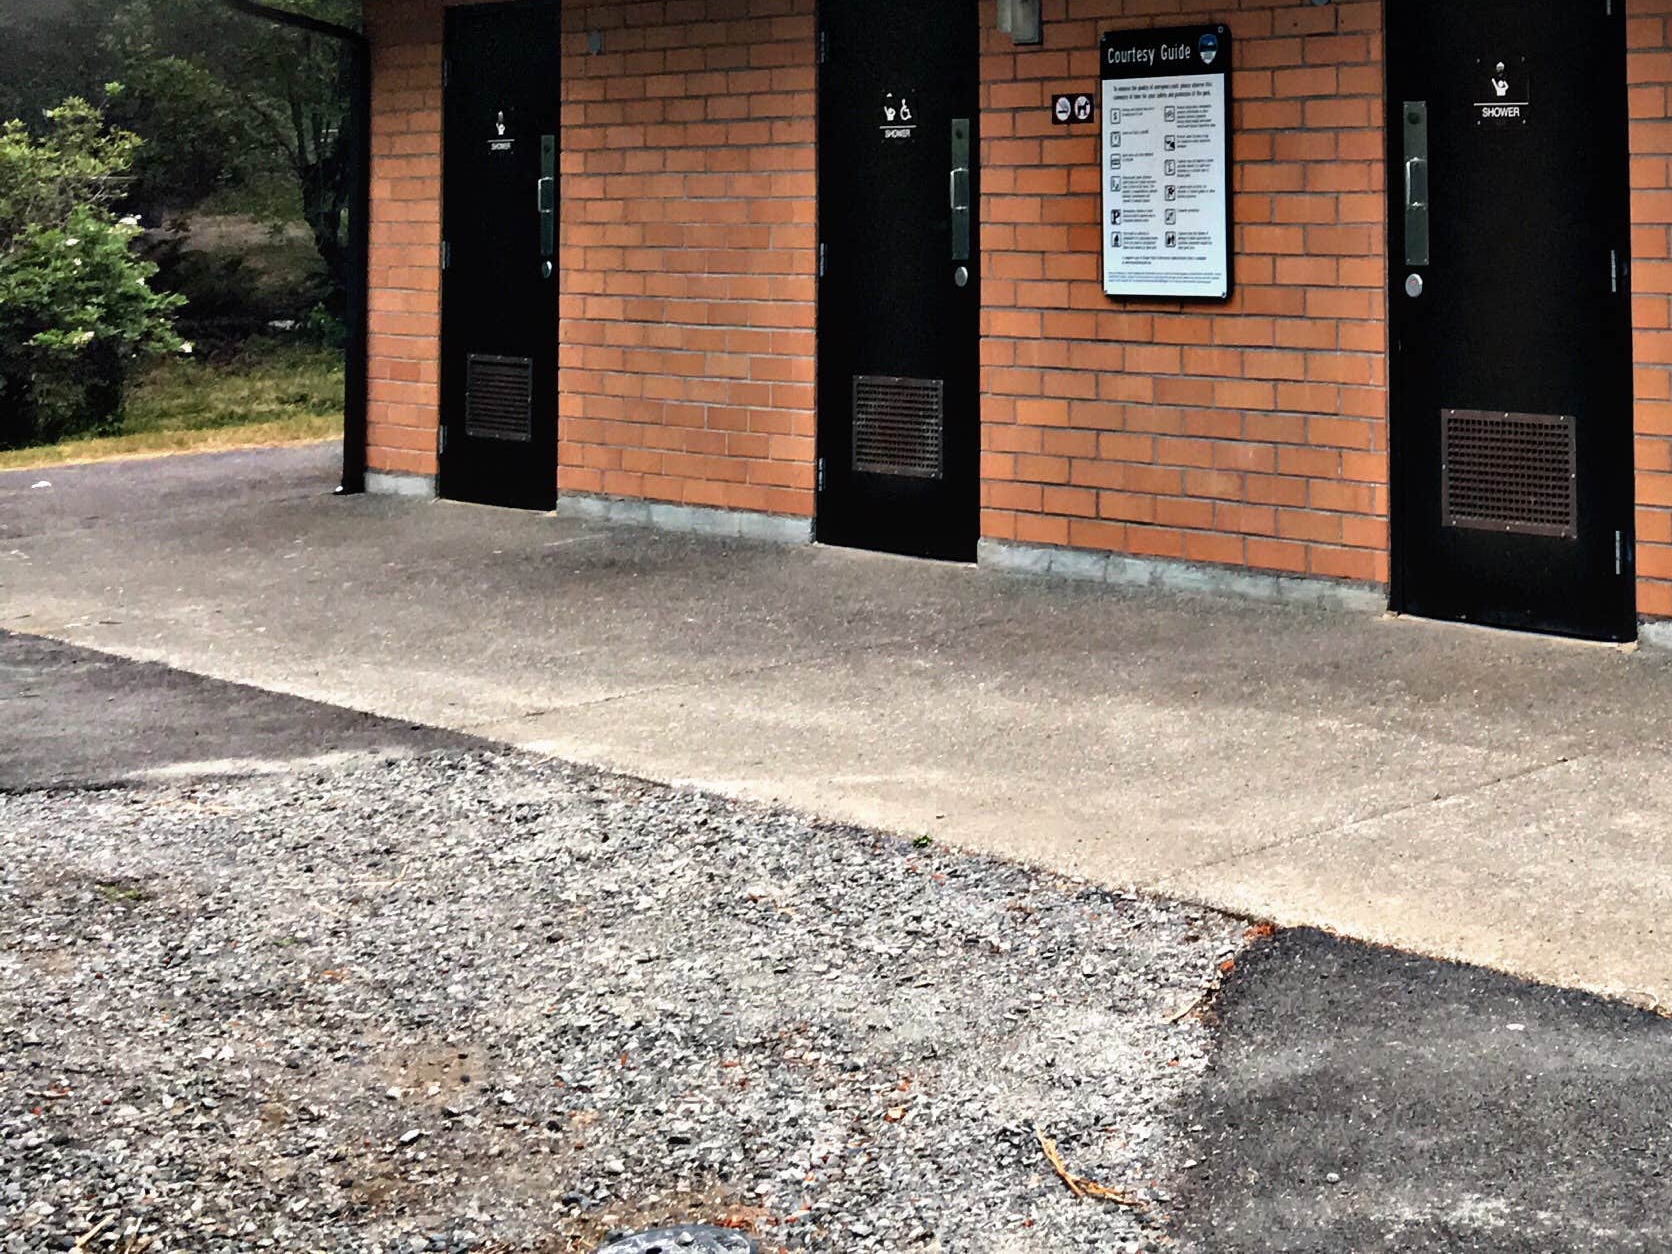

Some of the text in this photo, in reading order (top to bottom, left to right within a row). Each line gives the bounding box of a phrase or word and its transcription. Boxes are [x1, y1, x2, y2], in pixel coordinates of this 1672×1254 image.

[1108, 43, 1191, 66] Courtesy Guide
[1482, 107, 1520, 118] SHOWER
